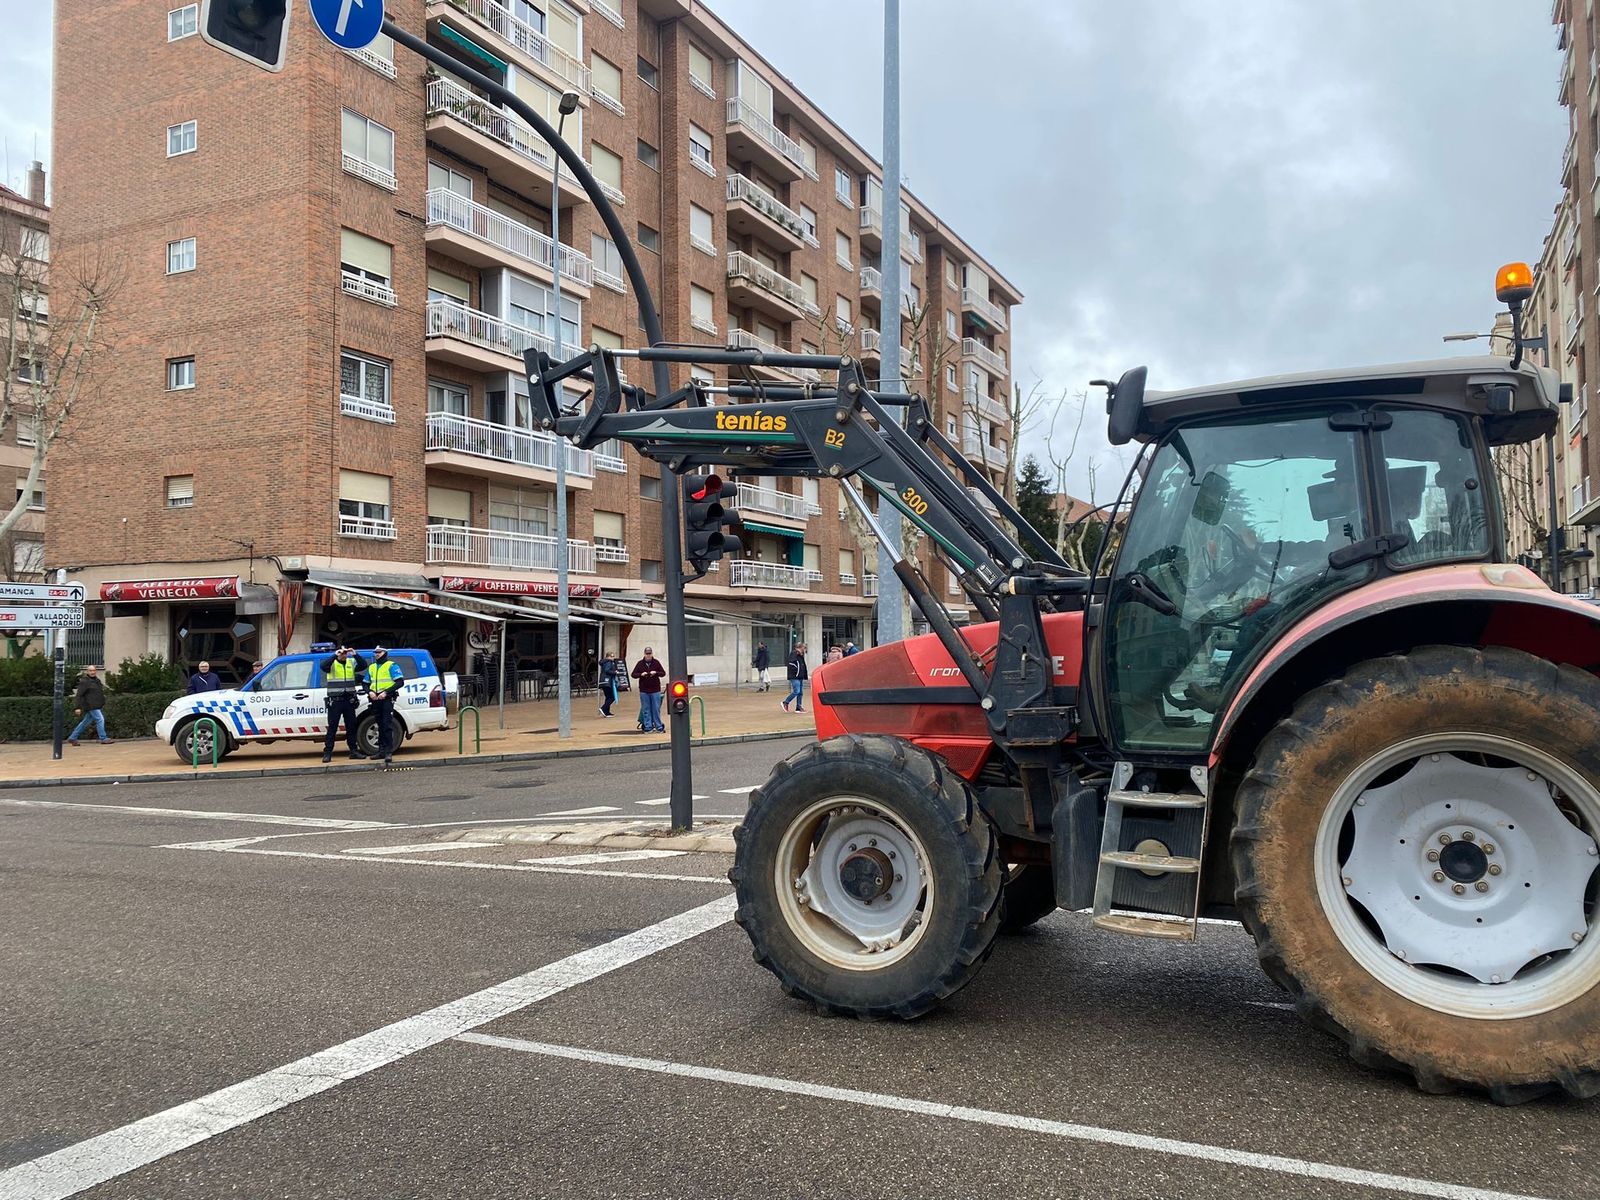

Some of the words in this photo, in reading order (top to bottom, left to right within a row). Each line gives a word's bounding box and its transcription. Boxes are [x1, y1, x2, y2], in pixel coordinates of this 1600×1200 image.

[715, 410, 787, 431] tenías
[825, 428, 846, 447] B2
[902, 487, 928, 515] 300
[133, 580, 206, 588] CAFETERIA
[485, 581, 529, 592] CAFETERIA
[533, 584, 559, 593] VENEC
[139, 588, 199, 598] VENECIA
[404, 683, 428, 693] 112
[262, 706, 294, 716] Policía
